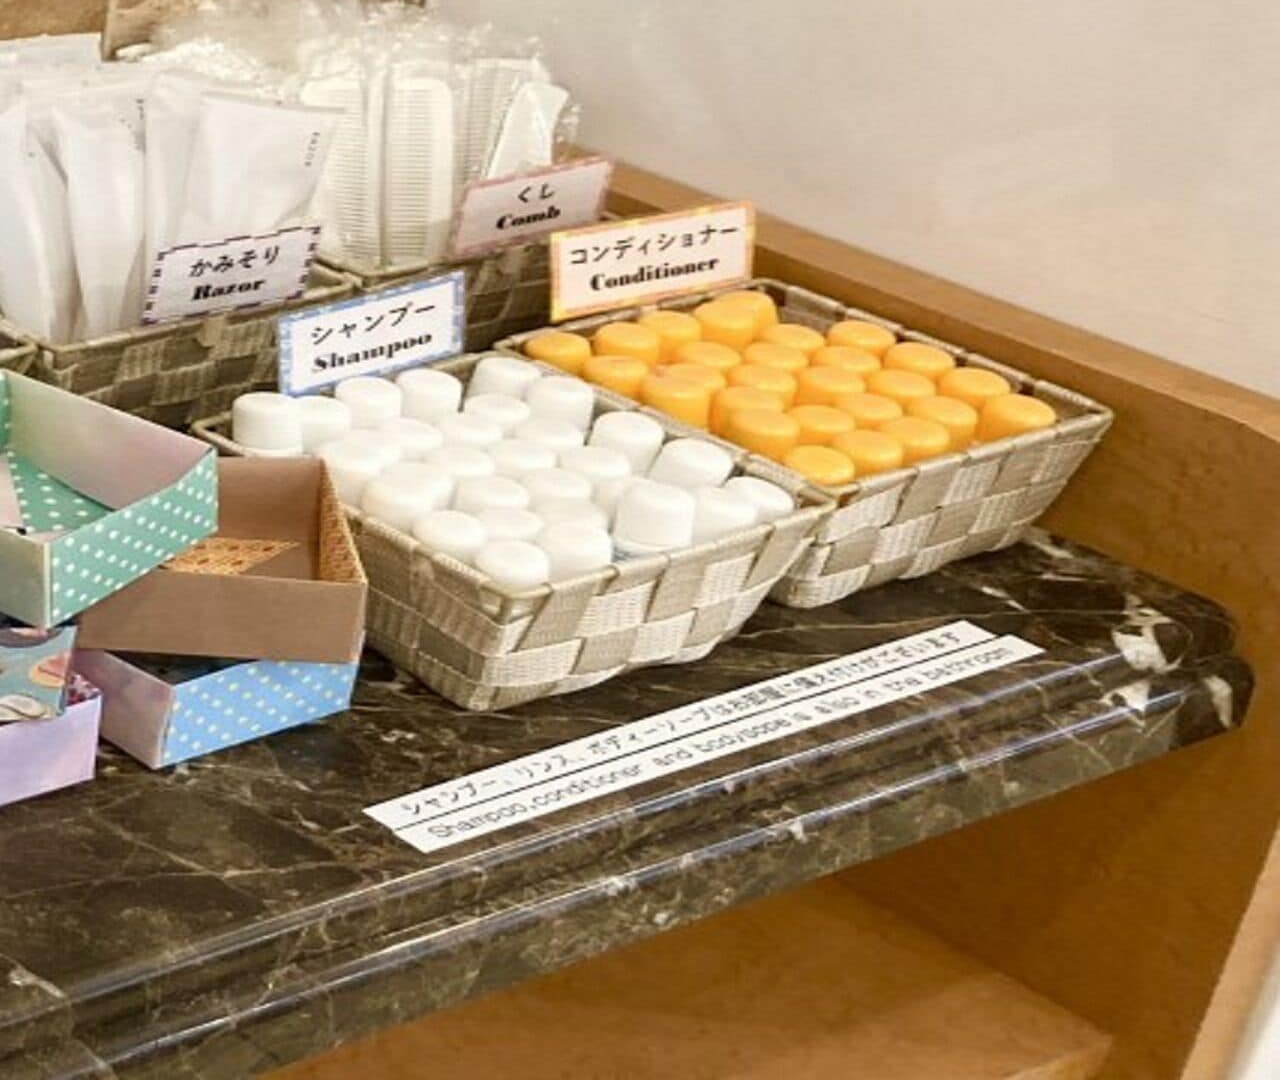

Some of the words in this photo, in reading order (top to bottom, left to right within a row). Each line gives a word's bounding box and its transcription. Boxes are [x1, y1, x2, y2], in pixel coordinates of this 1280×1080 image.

[517, 183, 556, 204] くし
[496, 205, 561, 230] Comb
[189, 245, 280, 278] かみそり
[570, 224, 739, 266] コンディショナー
[191, 279, 266, 301] Razor
[590, 256, 720, 292] Conditioner
[310, 301, 436, 346] シャンプー
[311, 333, 433, 372] Shampoo
